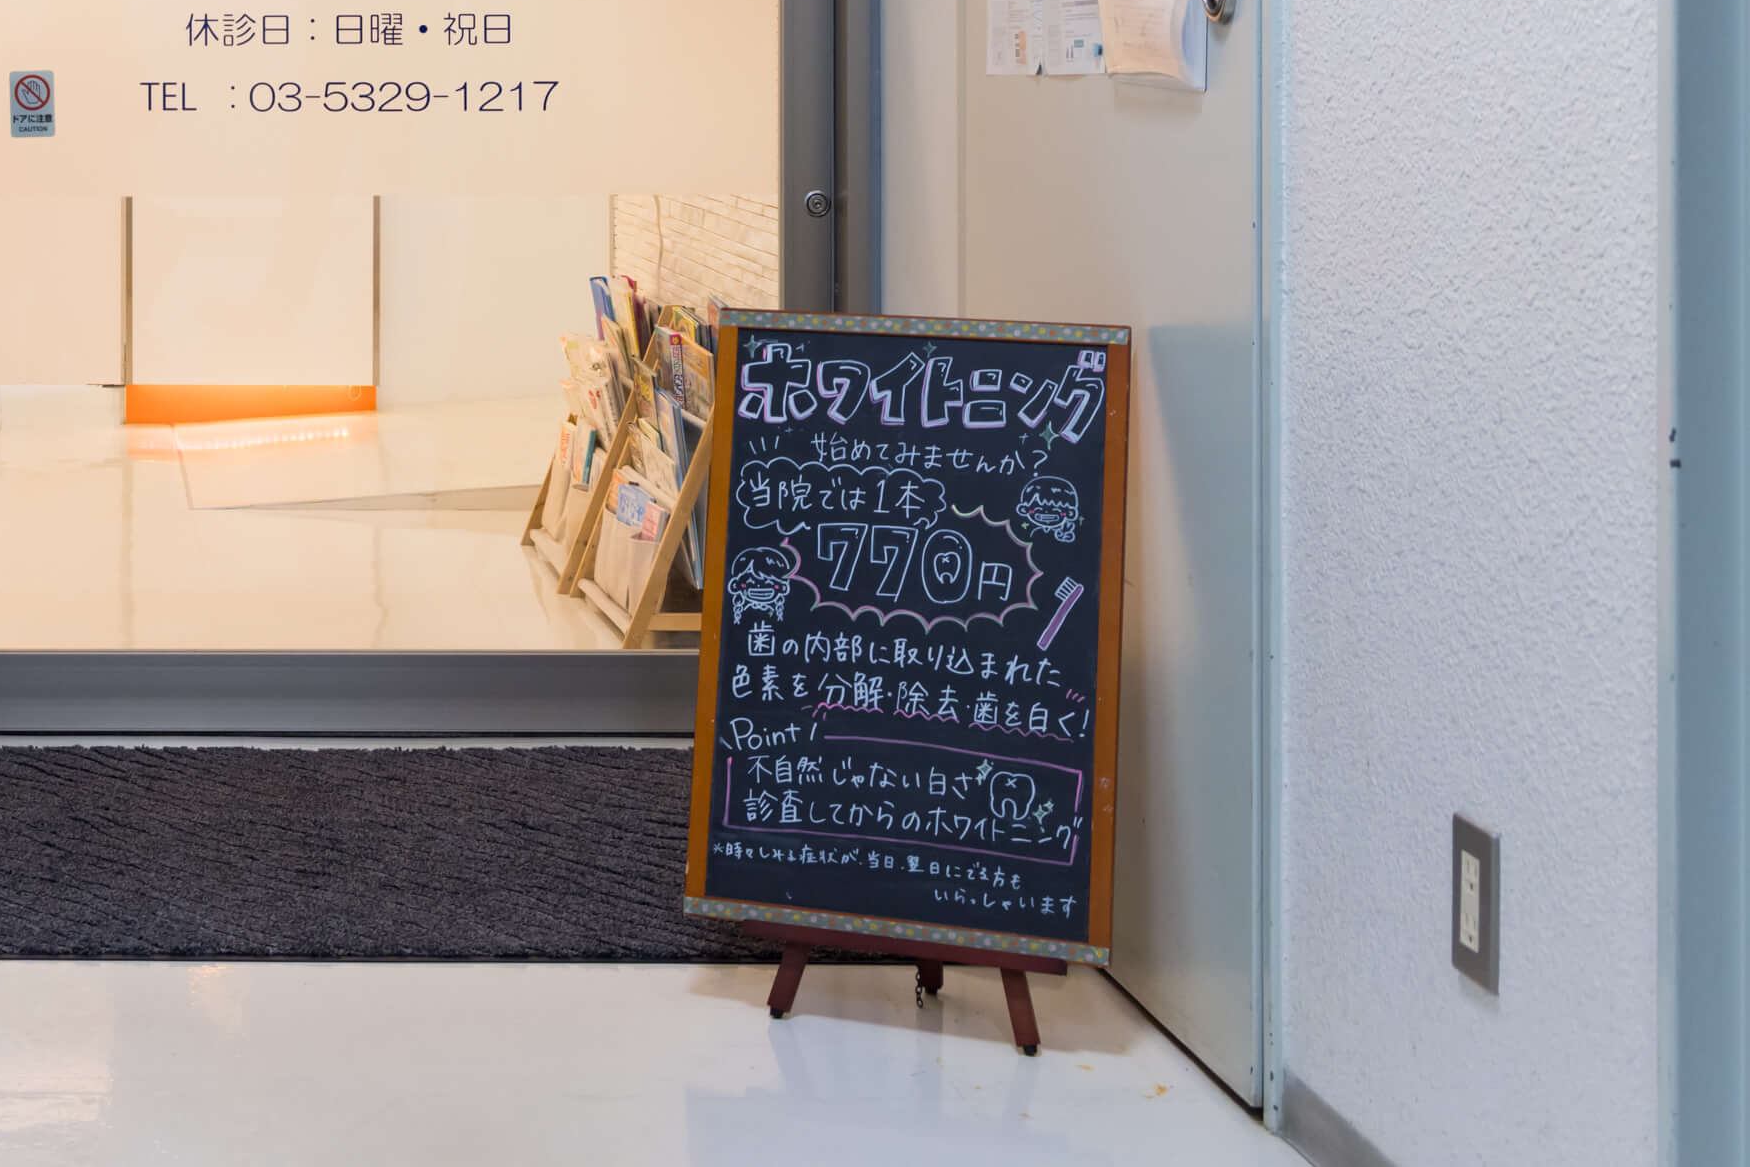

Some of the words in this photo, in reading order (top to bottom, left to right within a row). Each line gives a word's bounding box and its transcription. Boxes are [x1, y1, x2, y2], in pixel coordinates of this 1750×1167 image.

[12, 114, 53, 123] ドアに注意
[140, 81, 197, 112] TEL
[738, 343, 1107, 444] ホワイトニング
[749, 471, 925, 519] 当院では1本
[818, 523, 1012, 603] 770円
[748, 620, 1061, 687] 歯の内部に取り込まれた
[747, 756, 973, 800] 不自然じゃない白さ
[744, 789, 1083, 849] 診査してからのホワイトニング
[935, 889, 1077, 918] いらっしゃいます
